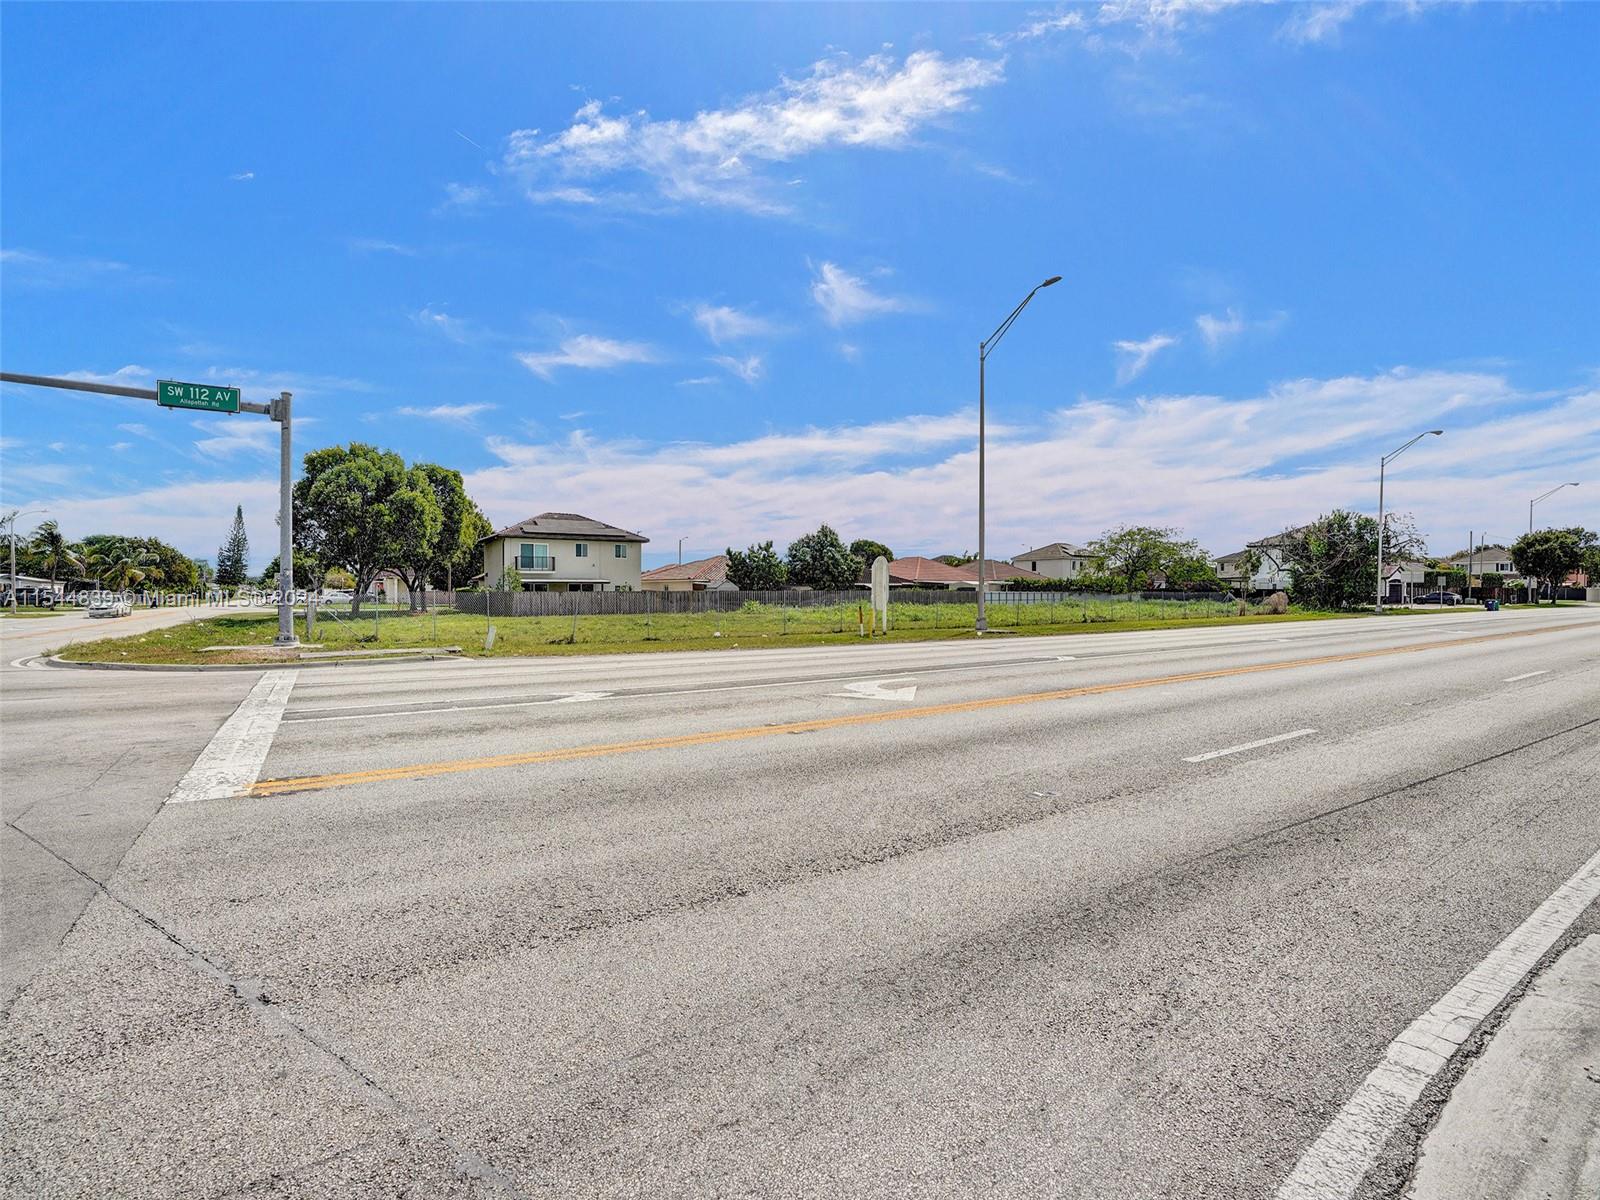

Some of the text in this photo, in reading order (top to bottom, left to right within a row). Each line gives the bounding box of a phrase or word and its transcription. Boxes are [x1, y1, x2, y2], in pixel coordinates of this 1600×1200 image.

[167, 386, 231, 401] SW 112 AV
